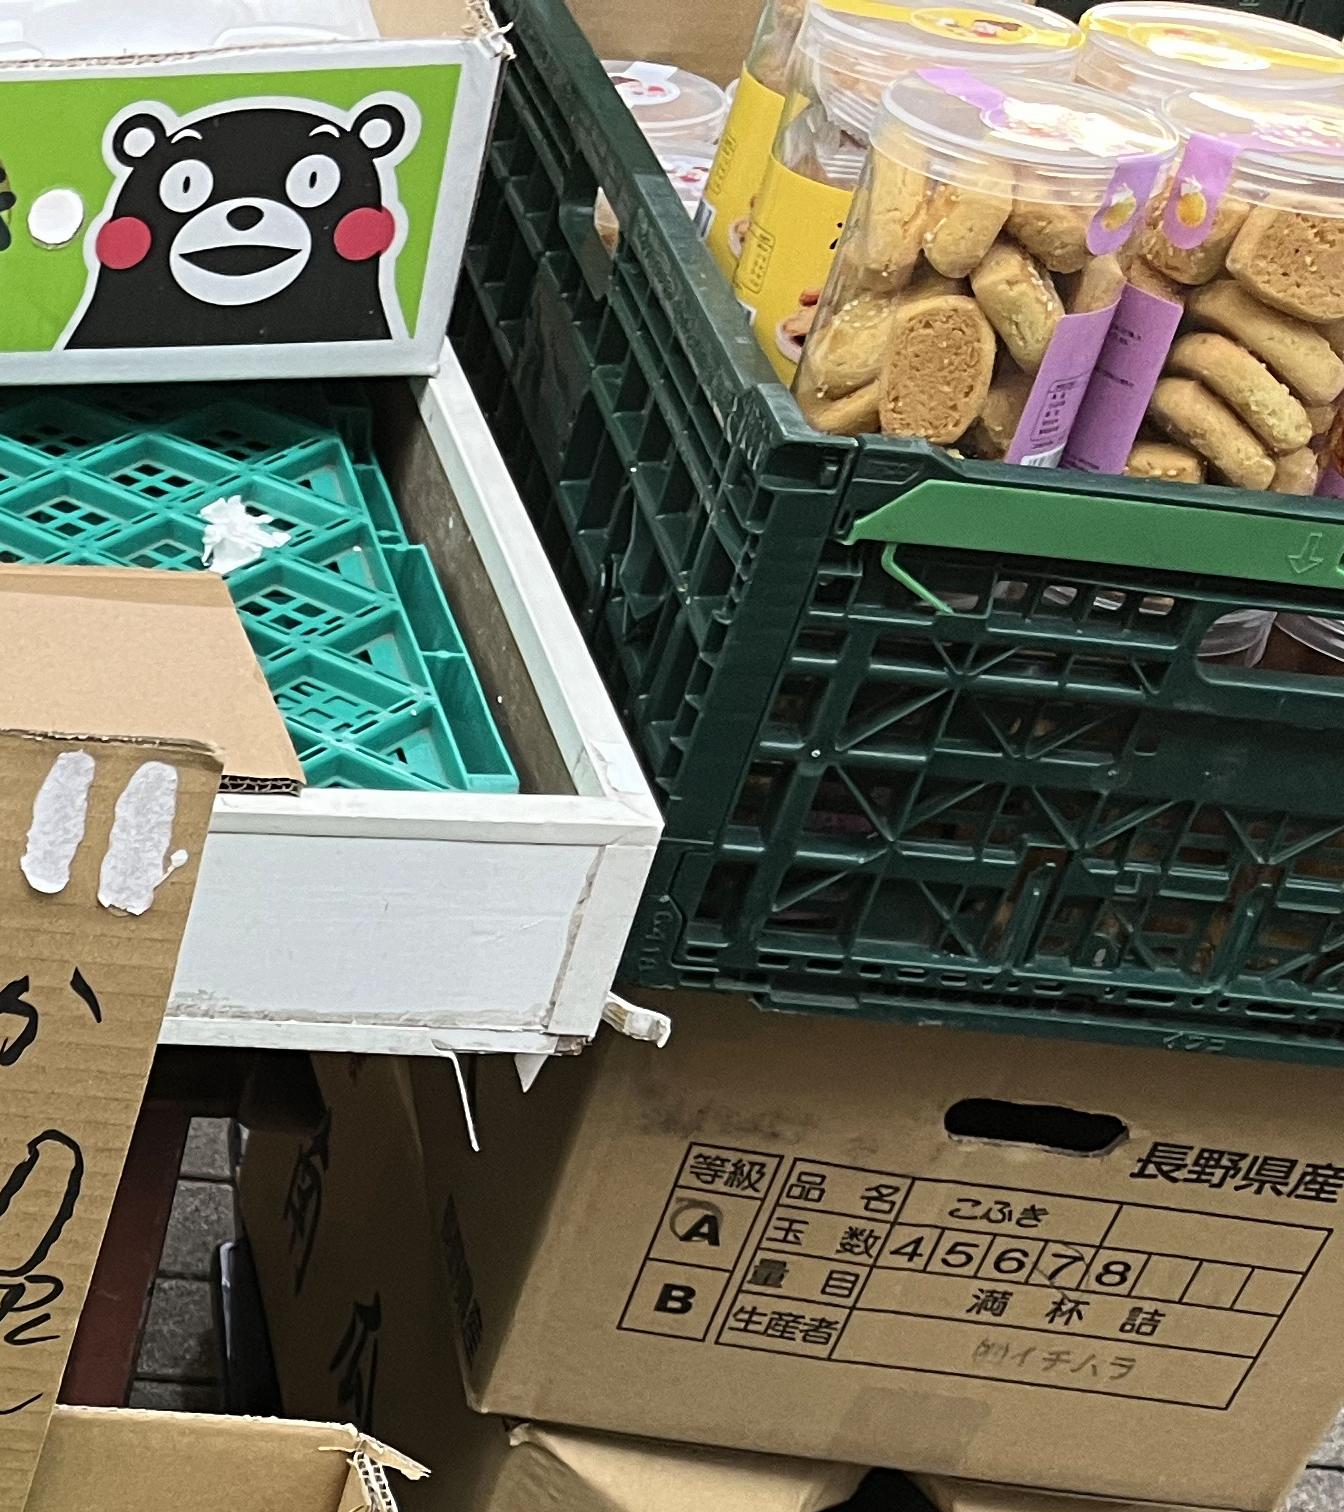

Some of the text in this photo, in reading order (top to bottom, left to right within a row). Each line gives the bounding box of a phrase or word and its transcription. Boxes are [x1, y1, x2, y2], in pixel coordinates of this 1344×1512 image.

[689, 1153, 766, 1193] 等級
[786, 1171, 900, 1214] 品名
[1129, 1141, 1344, 1202] 長野県産
[679, 1214, 721, 1246] A
[766, 1216, 1132, 1288] 玉数 4 5 6 7 8
[653, 1283, 696, 1315] B
[965, 1288, 1167, 1337] 満杯詰
[727, 1305, 840, 1346] 生産者
